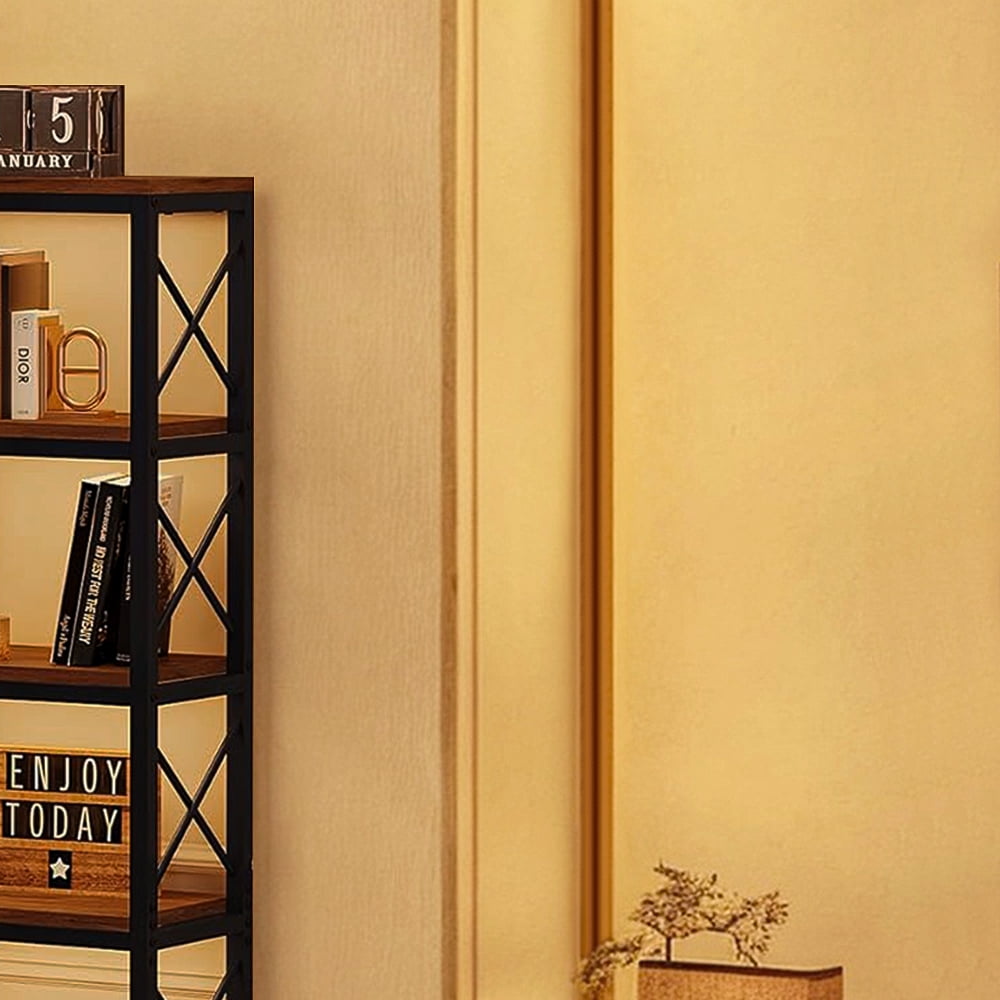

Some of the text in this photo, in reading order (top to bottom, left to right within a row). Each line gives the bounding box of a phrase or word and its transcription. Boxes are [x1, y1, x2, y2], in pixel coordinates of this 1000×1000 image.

[51, 96, 74, 144] 5
[18, 347, 30, 384] DIOR
[10, 754, 122, 795] ENJOY
[5, 802, 118, 842] TODAY
